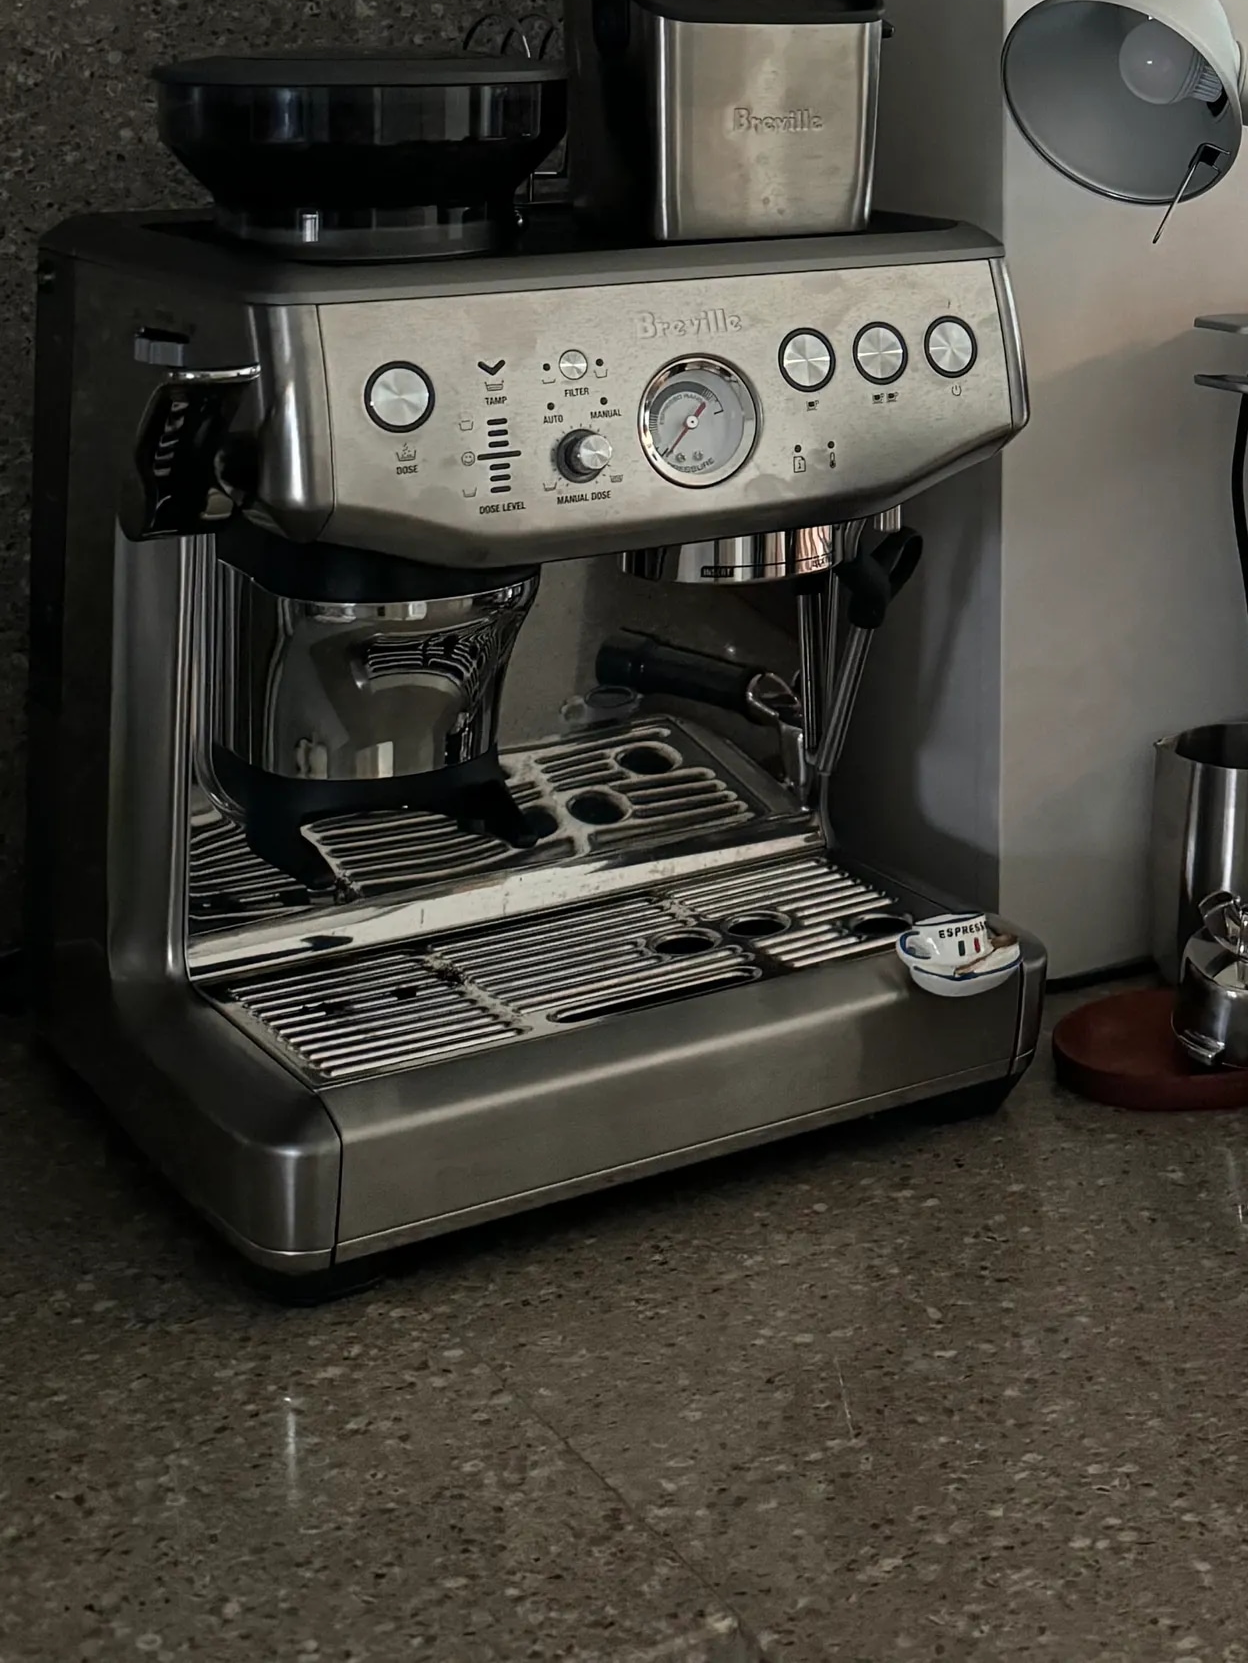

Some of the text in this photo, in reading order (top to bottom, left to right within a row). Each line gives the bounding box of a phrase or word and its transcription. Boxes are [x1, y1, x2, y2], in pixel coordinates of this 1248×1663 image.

[732, 107, 823, 133] Breville
[635, 308, 742, 338] Breville
[564, 387, 590, 398] FILTER
[484, 395, 508, 406] TAMP
[543, 414, 564, 425] AUTO
[590, 408, 622, 420] MANUAL
[396, 464, 419, 475] DOSE
[557, 490, 612, 505] MANUAL DOSE
[479, 501, 526, 515] DOSE LEVEL
